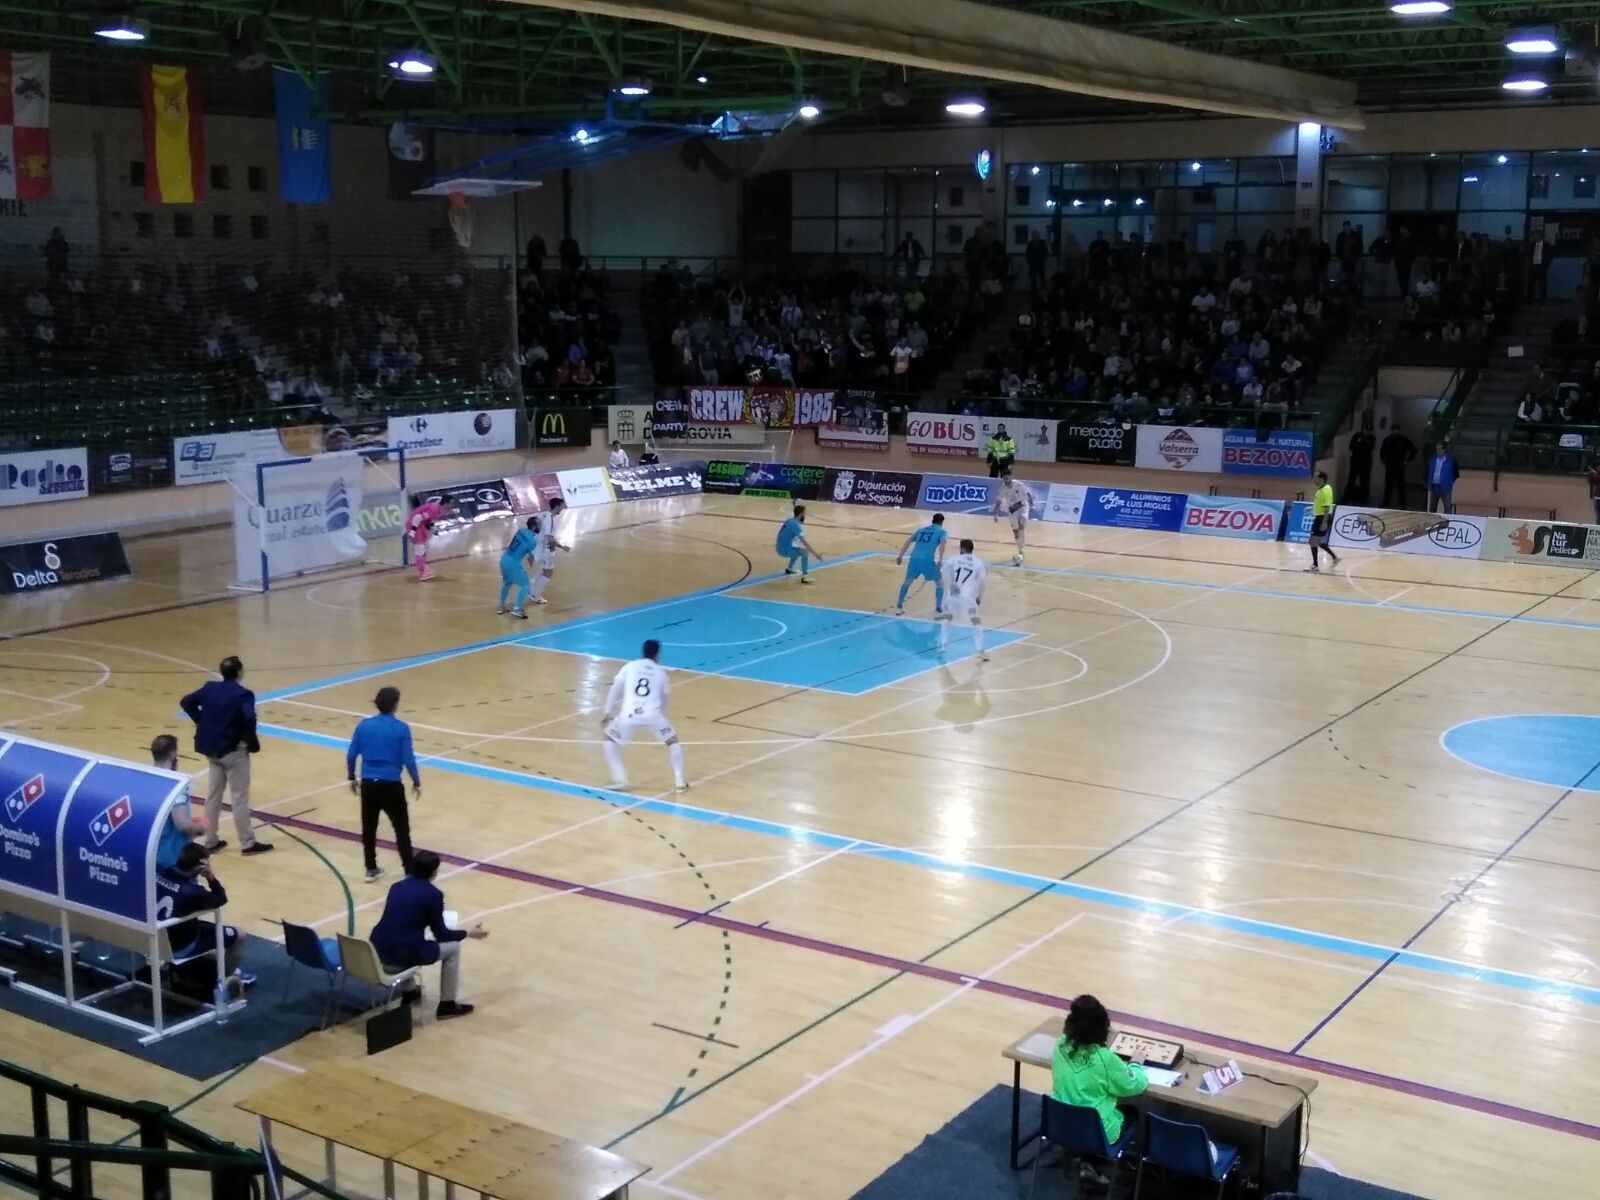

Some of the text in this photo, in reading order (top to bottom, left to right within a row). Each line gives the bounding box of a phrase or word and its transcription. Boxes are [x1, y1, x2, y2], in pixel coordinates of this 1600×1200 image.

[656, 400, 682, 411] CREW
[690, 389, 834, 424] CREW 1985
[653, 422, 686, 433] PARTY
[1070, 426, 1124, 439] mercado
[1089, 438, 1122, 450] plata
[1160, 442, 1199, 454] Valserra
[1224, 435, 1245, 443] AGUA
[1278, 438, 1312, 447] NATURAL
[1224, 447, 1310, 469] BEZOYA
[621, 475, 685, 491] KELME
[857, 480, 906, 494] Diputación
[854, 491, 903, 505] de Segovia
[926, 483, 987, 504] moltex
[1130, 493, 1172, 503] ALUMINIOS
[1143, 502, 1172, 511] MIGUEL
[1186, 507, 1275, 533] BEZOYA
[1341, 518, 1377, 536] EPAL
[1436, 527, 1472, 544] EPAL
[1552, 539, 1568, 547] tur
[1553, 531, 1566, 540] Na
[1550, 546, 1571, 555] Pellet
[13, 570, 58, 588] Delta
[955, 567, 973, 583] 17
[635, 677, 650, 697] 8
[5, 841, 32, 860] Pizza
[79, 846, 128, 872] Domino's
[90, 866, 119, 886] Pizza
